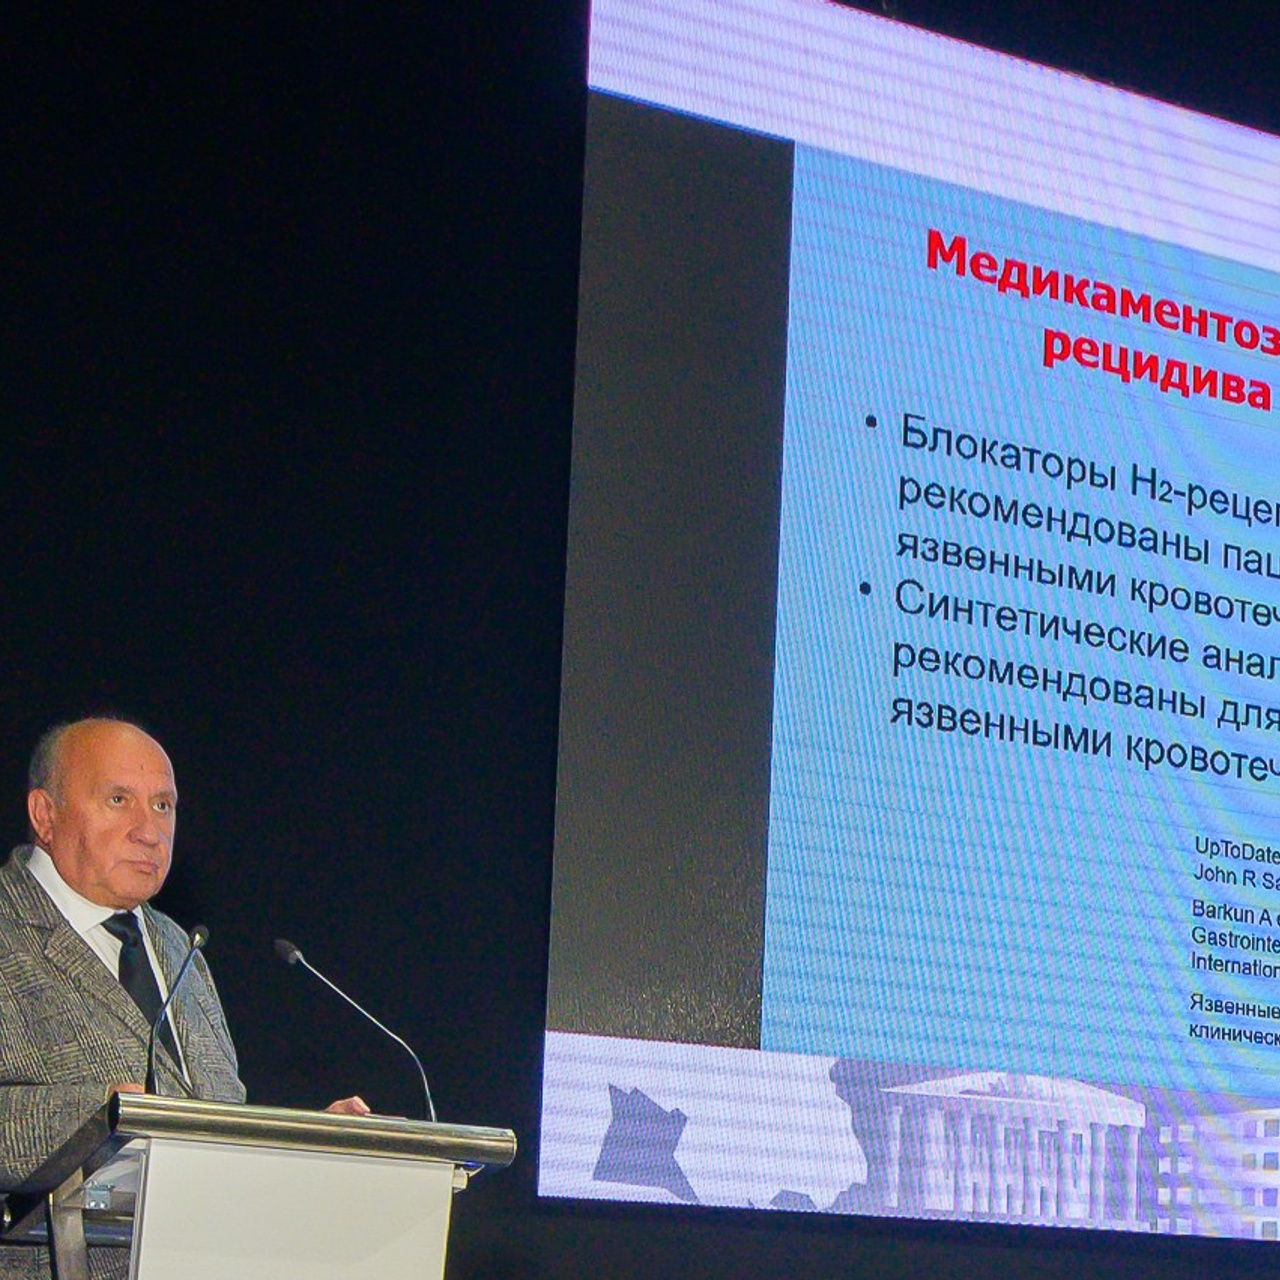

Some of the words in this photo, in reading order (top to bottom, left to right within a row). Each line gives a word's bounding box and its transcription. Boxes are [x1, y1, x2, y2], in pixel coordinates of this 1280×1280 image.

[1043, 328, 1272, 411] рецидива
[902, 412, 1117, 491] Блокаторы
[898, 475, 1210, 565] рекомендованы
[896, 532, 1117, 598] язвенными
[895, 578, 1190, 663] Синтетические
[893, 641, 1205, 719] рекомендованы
[890, 697, 1112, 758] язвенными
[1192, 899, 1255, 925] Barkun
[1258, 907, 1273, 927] A
[1193, 863, 1238, 886] John
[1242, 869, 1257, 888] R
